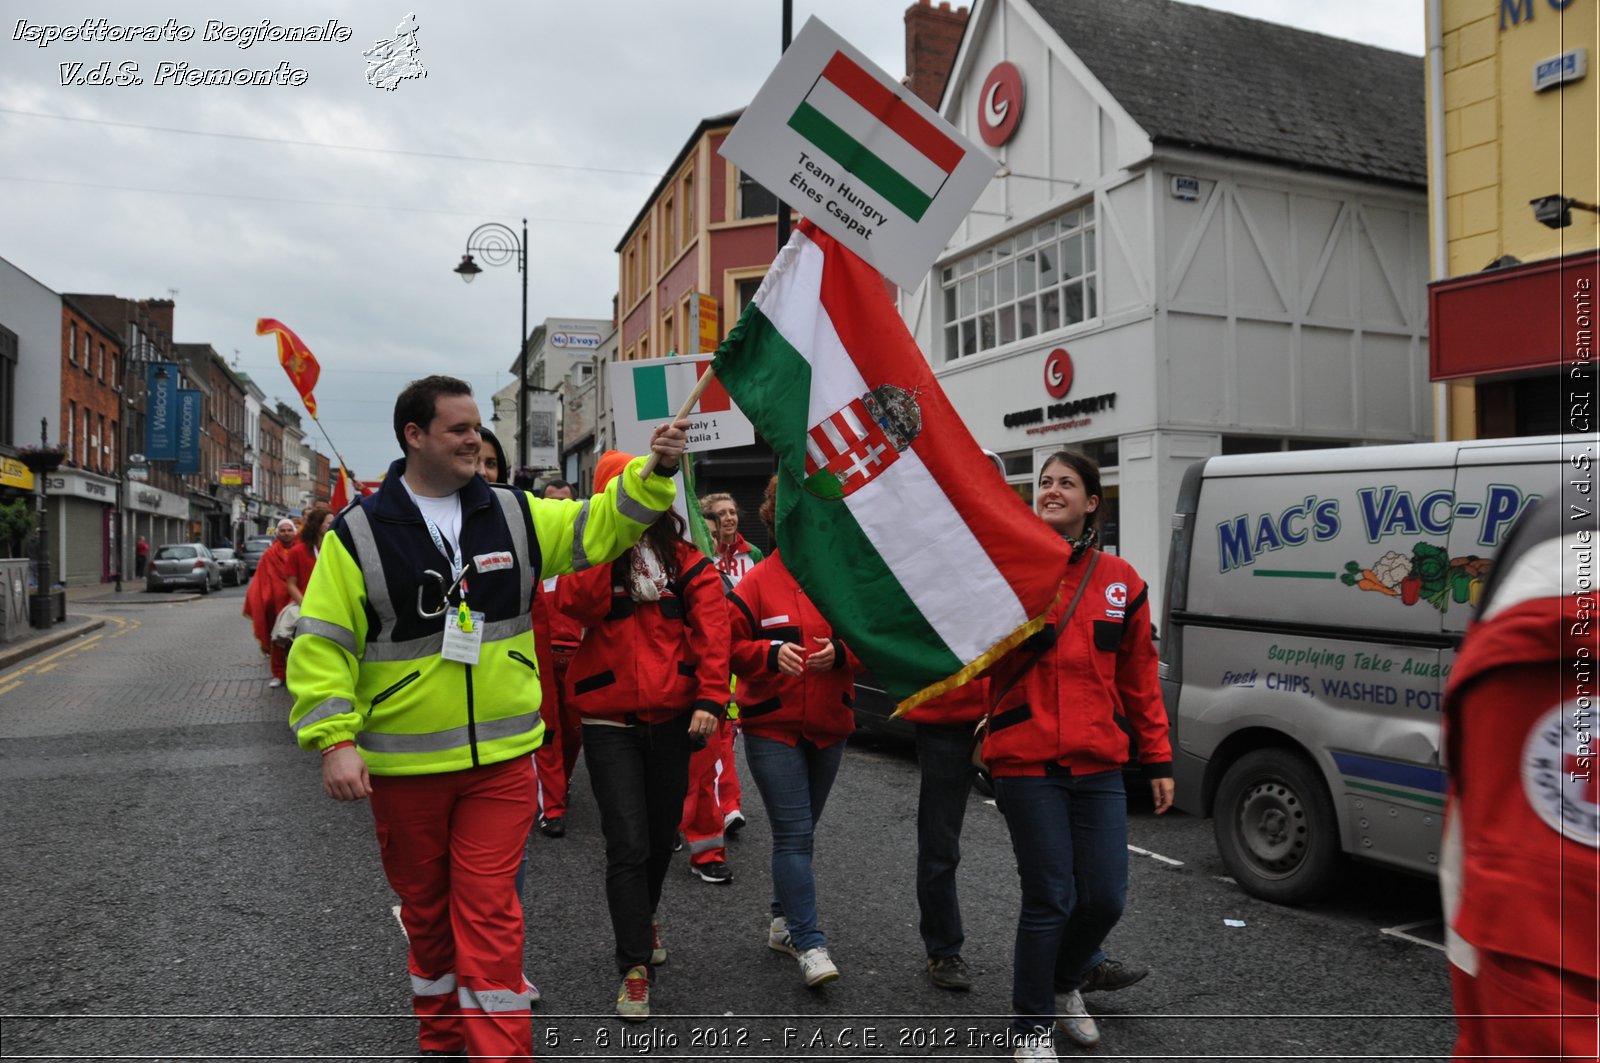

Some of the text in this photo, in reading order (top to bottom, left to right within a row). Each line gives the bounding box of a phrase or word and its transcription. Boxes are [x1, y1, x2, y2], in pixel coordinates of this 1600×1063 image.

[789, 171, 873, 240] Éhes Csapat
[798, 152, 888, 226] Team Hungry
[180, 396, 193, 448] Welcome
[690, 419, 718, 430] taly 1
[1047, 392, 1117, 420] PROPERTY
[686, 432, 720, 443] talia 1
[1217, 496, 1340, 573] MAC'S
[1267, 644, 1346, 670] Supplying
[1222, 669, 1444, 711] Fresh CHIPS, WASHED POT
